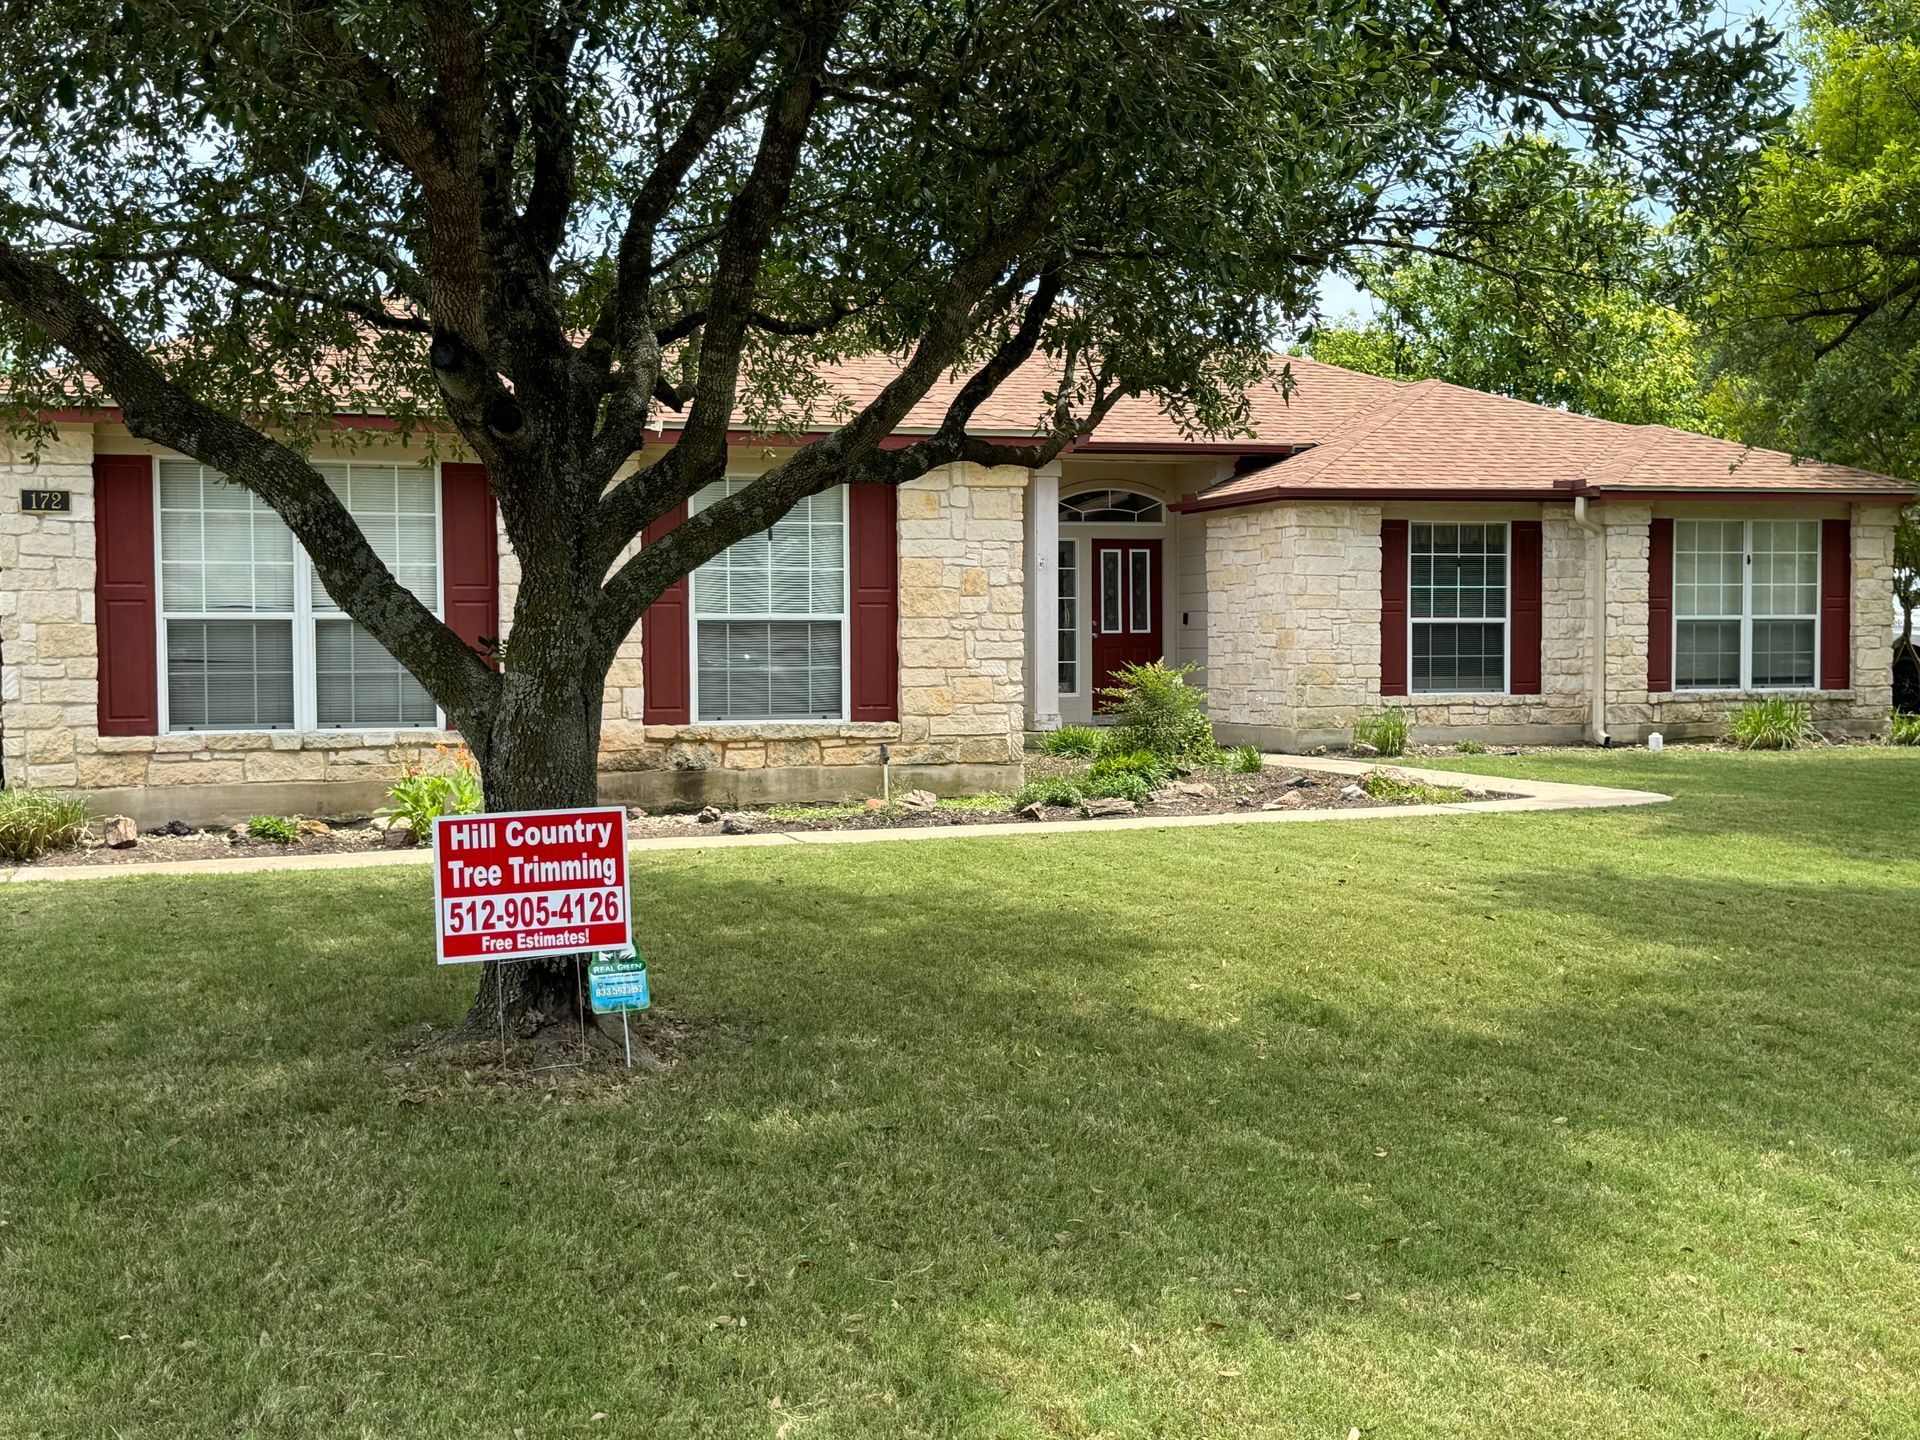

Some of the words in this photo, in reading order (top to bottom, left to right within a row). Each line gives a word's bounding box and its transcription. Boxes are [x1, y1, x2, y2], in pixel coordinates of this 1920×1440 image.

[31, 492, 62, 509] 172
[450, 823, 496, 850] Hill
[505, 818, 613, 849] Country
[448, 860, 502, 889] Tree
[508, 852, 616, 886] Trimming
[449, 891, 619, 933] 512-905-4126
[482, 935, 513, 952] Free
[517, 928, 590, 949] Estimates!
[593, 966, 615, 975] REAL
[617, 963, 642, 972] GREEN
